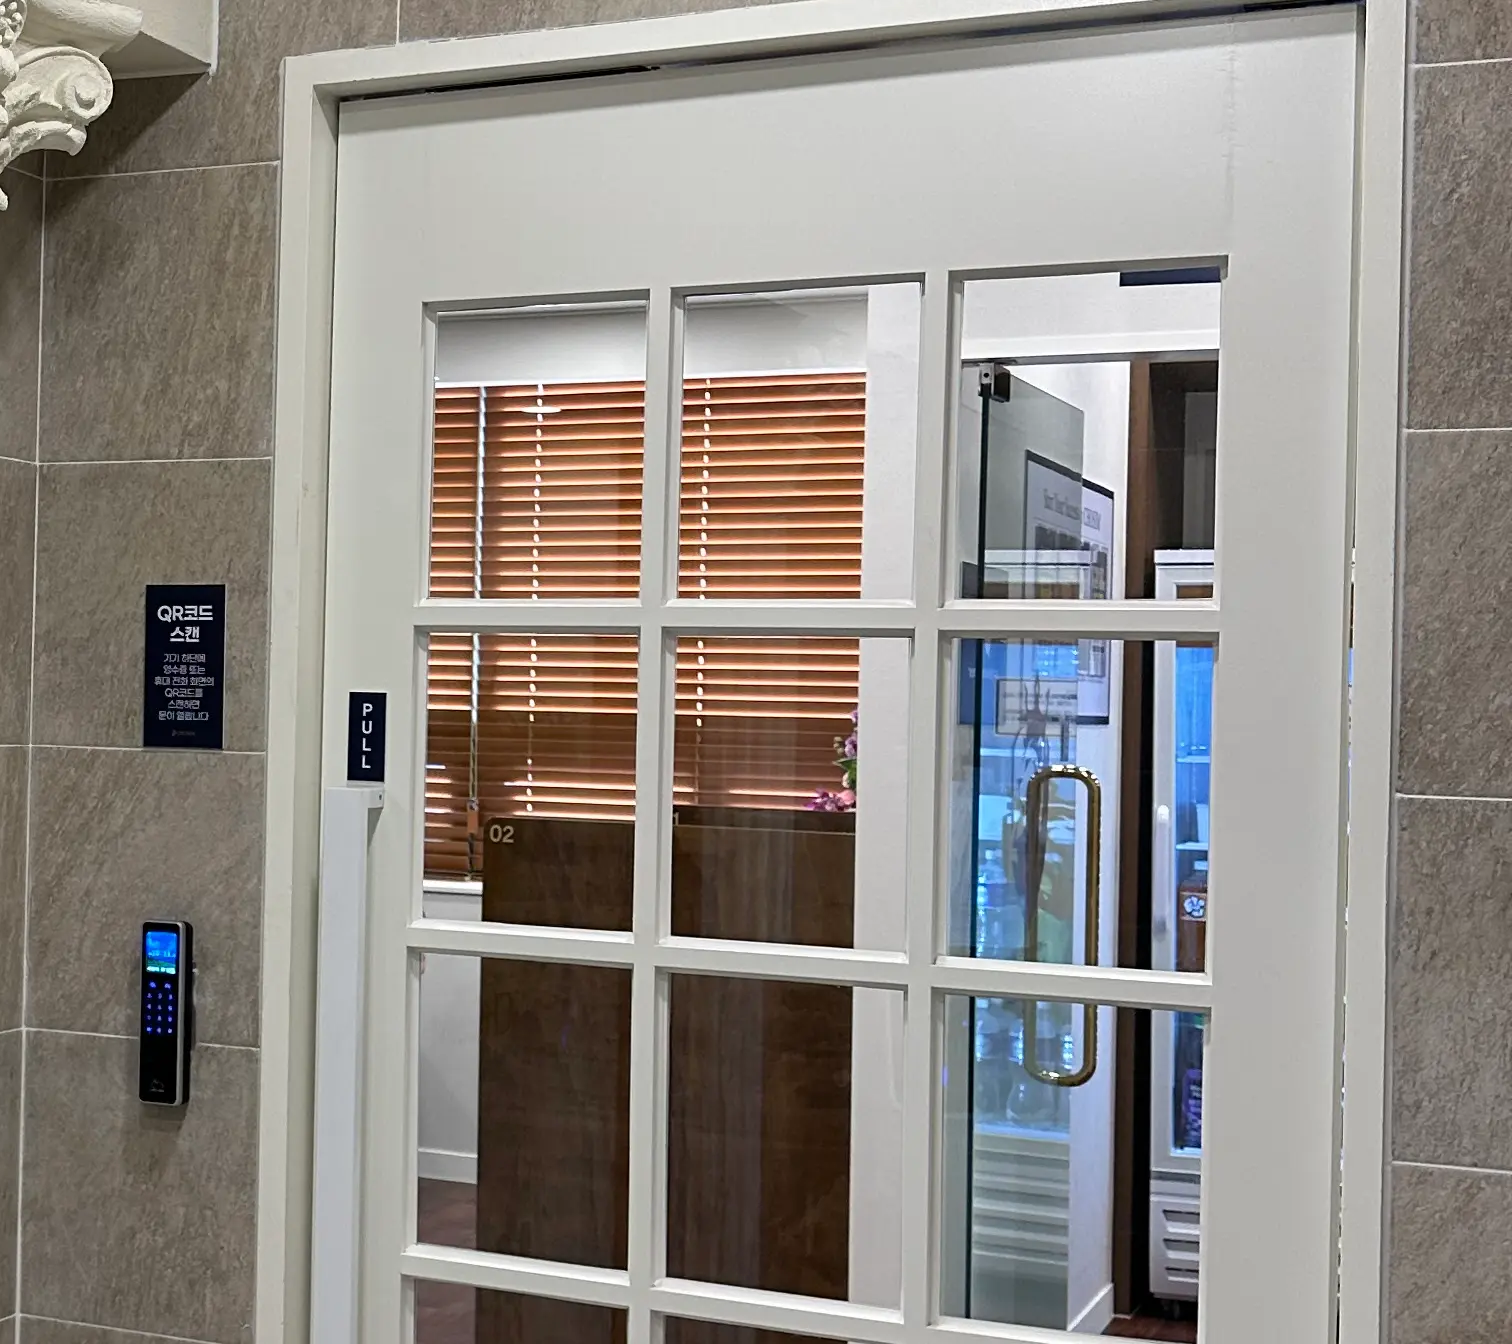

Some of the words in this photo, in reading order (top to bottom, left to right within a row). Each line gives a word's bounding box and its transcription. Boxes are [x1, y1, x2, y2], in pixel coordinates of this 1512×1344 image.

[157, 605, 213, 622] QR코드
[170, 626, 199, 642] 스캔
[361, 702, 373, 769] PULL
[490, 824, 514, 843] 02
